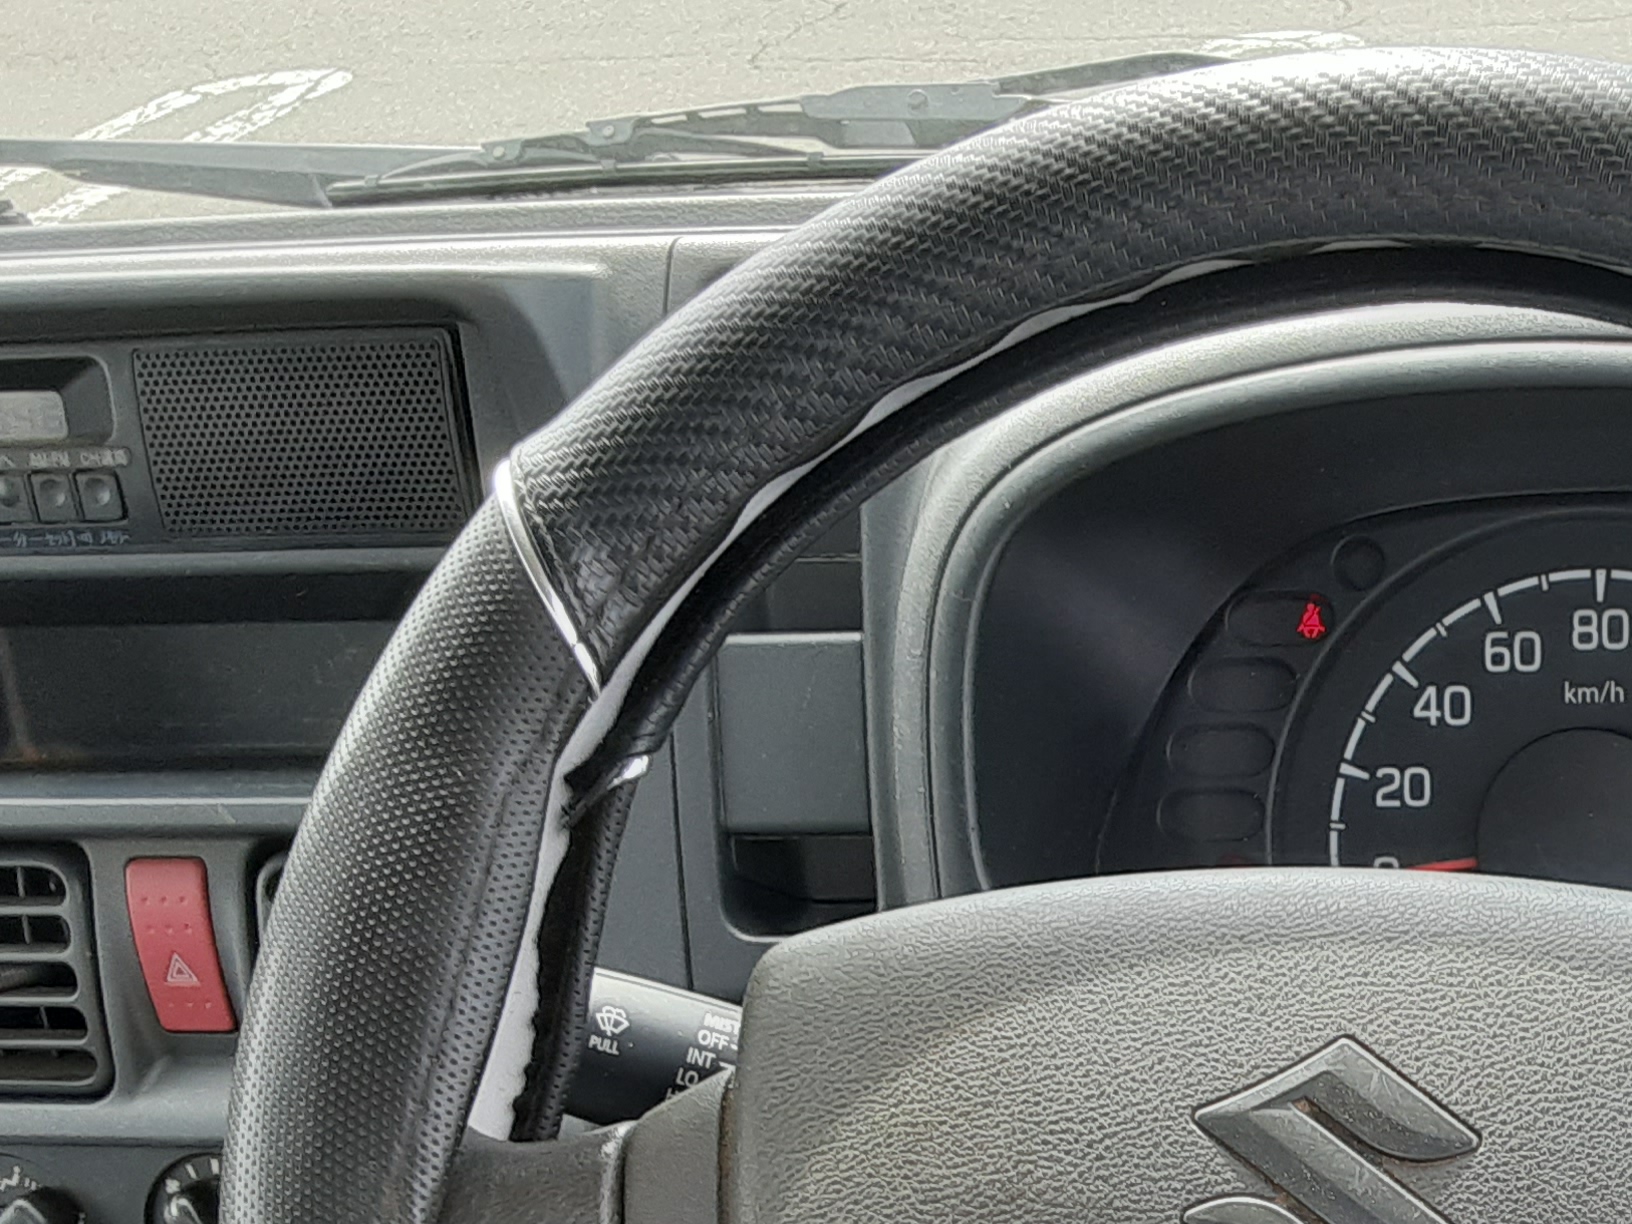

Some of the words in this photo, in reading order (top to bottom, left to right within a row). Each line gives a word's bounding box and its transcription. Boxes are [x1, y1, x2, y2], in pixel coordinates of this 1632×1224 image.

[1572, 609, 1629, 650] 80
[1484, 631, 1542, 673] 60
[1564, 680, 1624, 704] km/h
[1413, 685, 1472, 727] 40
[1375, 766, 1431, 808] 20
[704, 1012, 741, 1035] MIST
[588, 1034, 620, 1056] PULL
[697, 1029, 730, 1051] OFF
[686, 1046, 716, 1069] INT
[676, 1068, 699, 1087] LO
